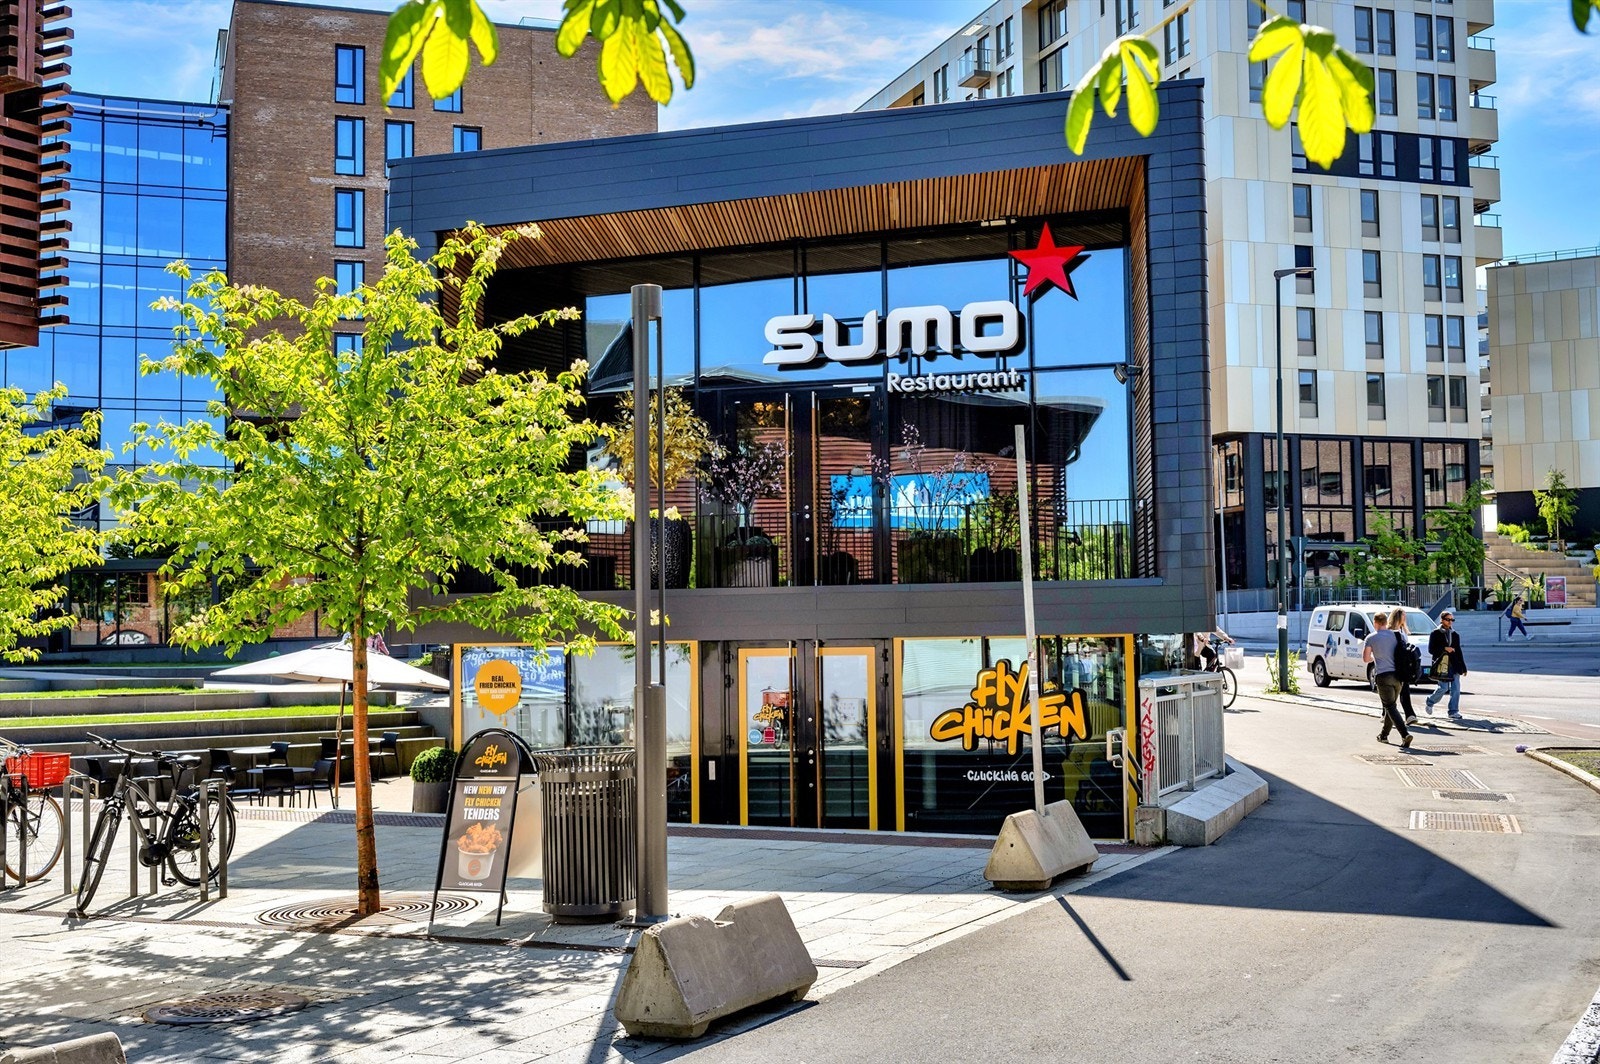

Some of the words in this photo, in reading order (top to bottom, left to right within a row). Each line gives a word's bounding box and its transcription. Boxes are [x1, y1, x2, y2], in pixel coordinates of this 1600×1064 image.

[762, 299, 1019, 366] SUMO
[887, 367, 1019, 393] Restaurant
[463, 785, 478, 795] NEW
[478, 785, 492, 795] NEW
[492, 785, 507, 795] NEW
[464, 797, 475, 807] FLY
[475, 797, 502, 807] CHICKEN
[463, 808, 500, 821] TENDERS
